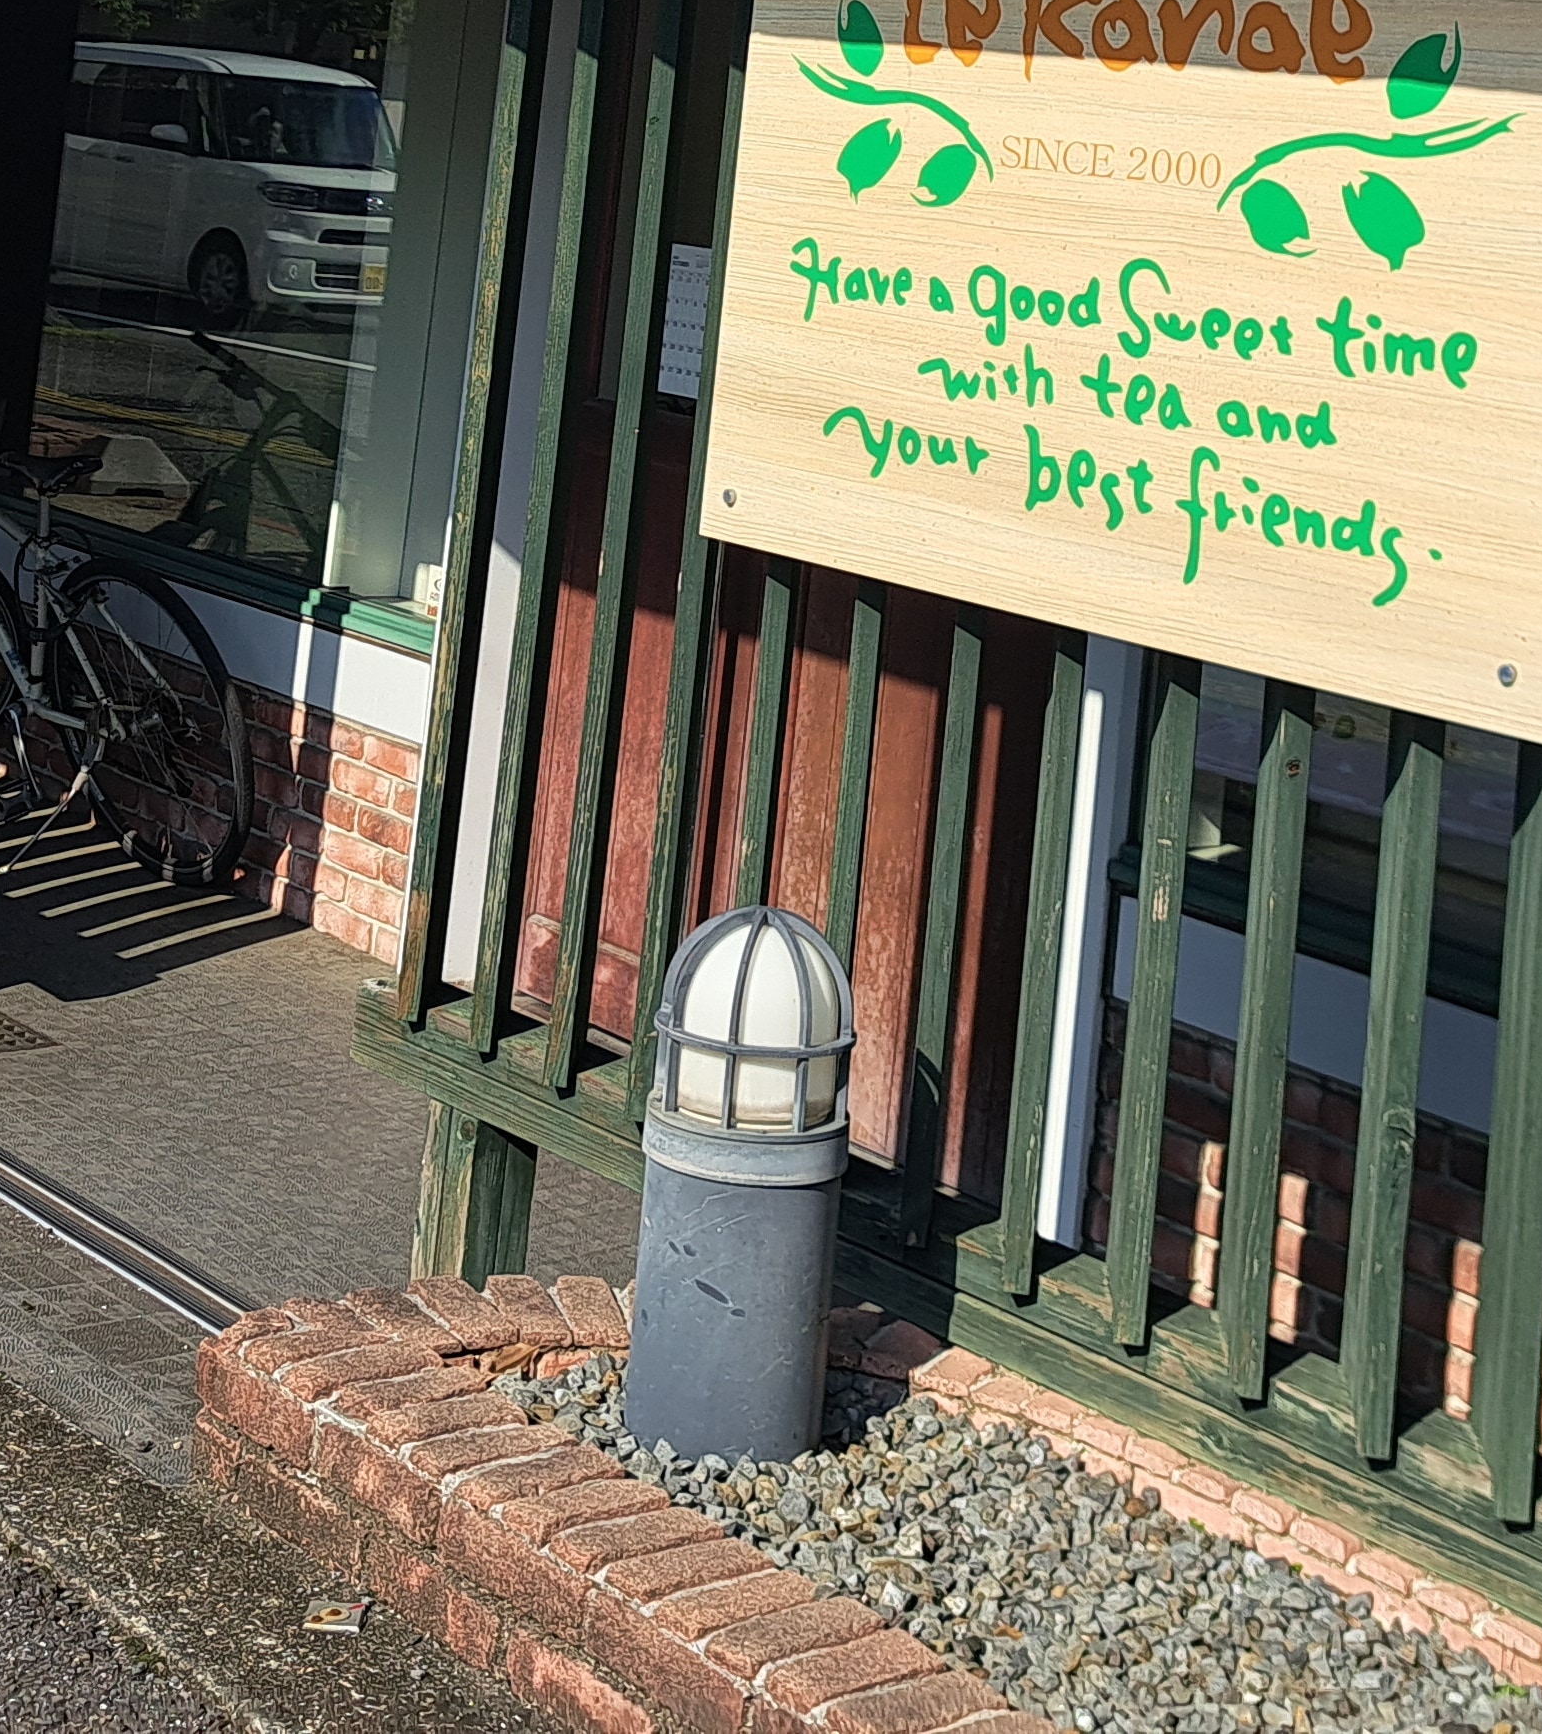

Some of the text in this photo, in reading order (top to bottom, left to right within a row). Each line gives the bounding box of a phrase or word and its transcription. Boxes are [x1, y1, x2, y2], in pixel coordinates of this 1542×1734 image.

[999, 134, 1222, 189] SINCE 2000
[789, 238, 913, 321] Have
[929, 276, 955, 313] a
[968, 264, 1102, 347] good
[1316, 297, 1479, 389] time
[917, 343, 1338, 450] with tea and
[822, 406, 990, 479] your
[1024, 424, 1155, 531] best
